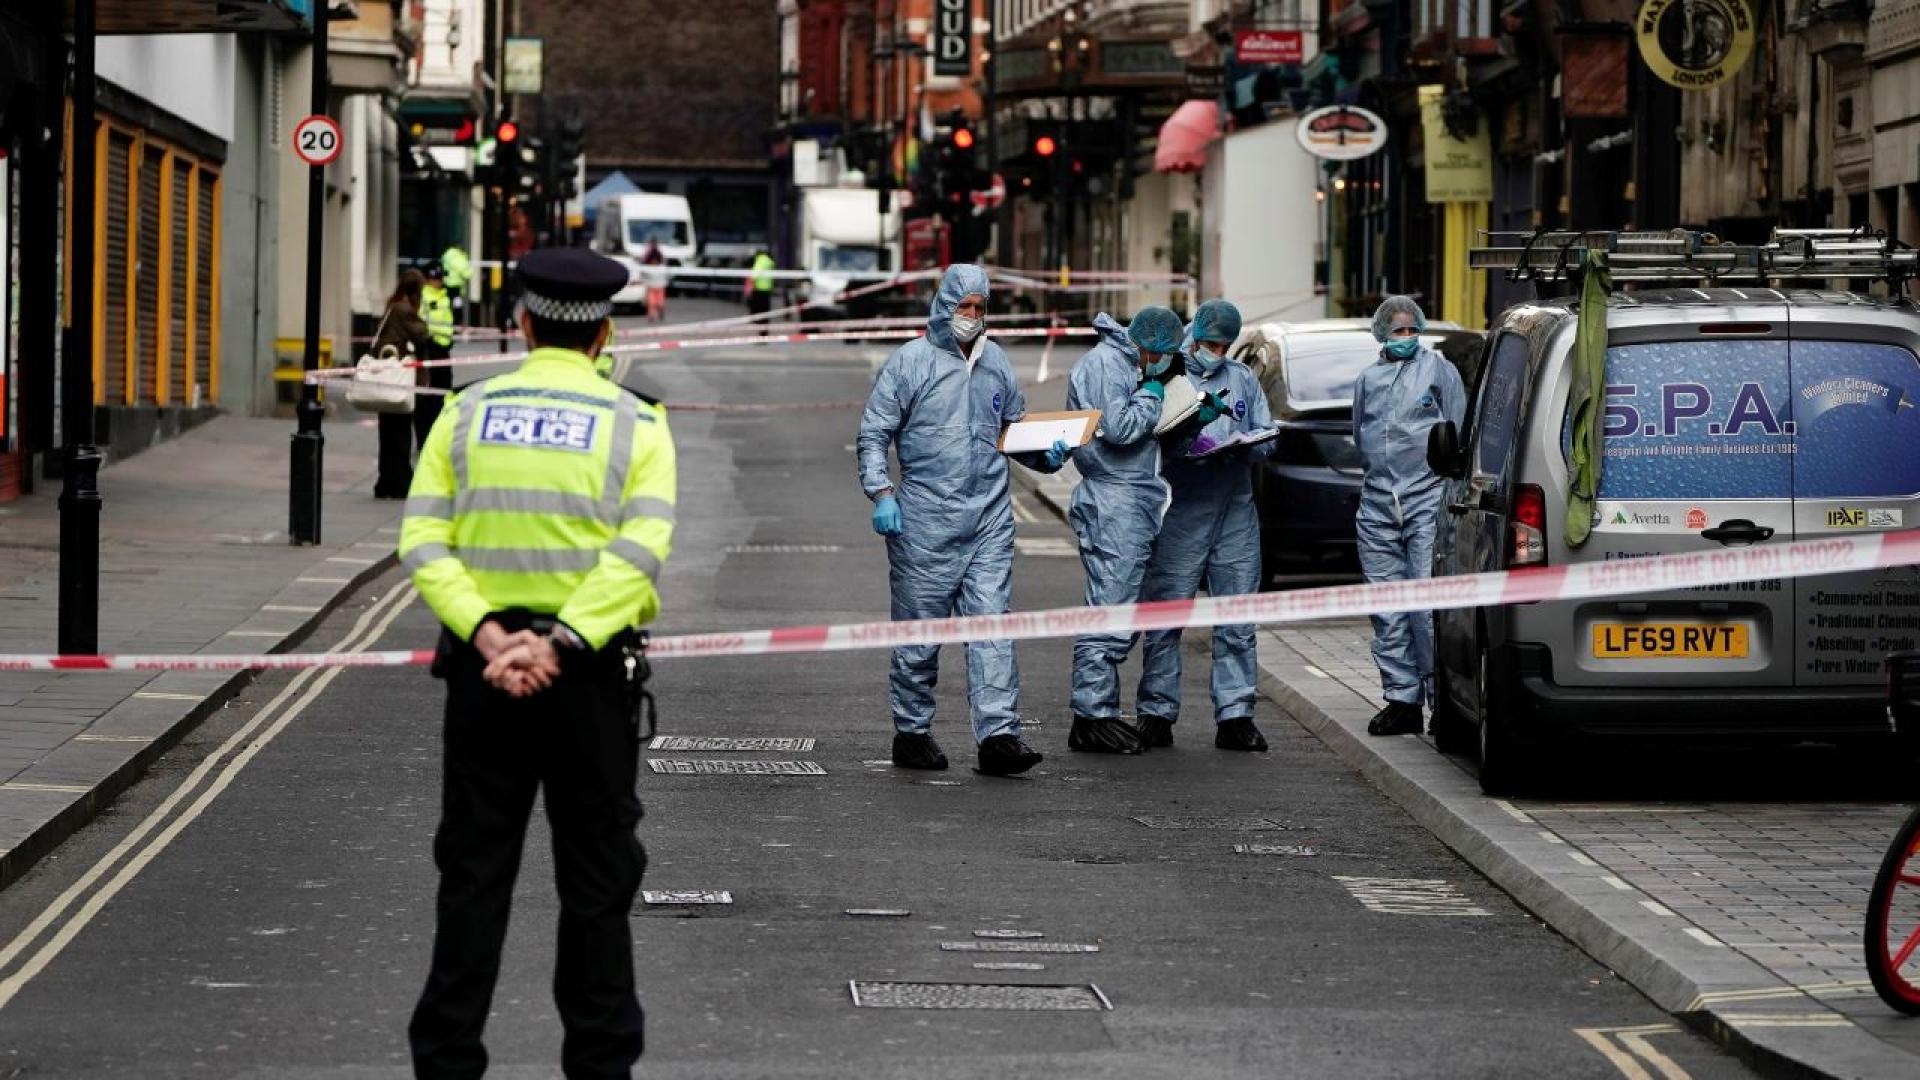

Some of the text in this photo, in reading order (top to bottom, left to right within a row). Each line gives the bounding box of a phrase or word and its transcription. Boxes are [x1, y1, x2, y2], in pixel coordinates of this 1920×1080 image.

[1672, 68, 1724, 85] LONDON
[302, 131, 335, 150] 20
[1844, 377, 1889, 397] Cleaners
[1604, 382, 1797, 439] S.P.A.
[485, 418, 588, 448] POLICE
[1661, 445, 1692, 456] Reliable
[1695, 444, 1720, 456] Family
[1723, 444, 1759, 454] Business
[1630, 512, 1671, 525] Avetta
[1828, 507, 1863, 525] IPAF
[1817, 591, 1920, 606] Commercial Cleani
[1816, 614, 1874, 629] Traditional
[1606, 627, 1735, 651] LF69 RVT
[1814, 659, 1841, 673] Pure
[1845, 659, 1880, 673] Water
